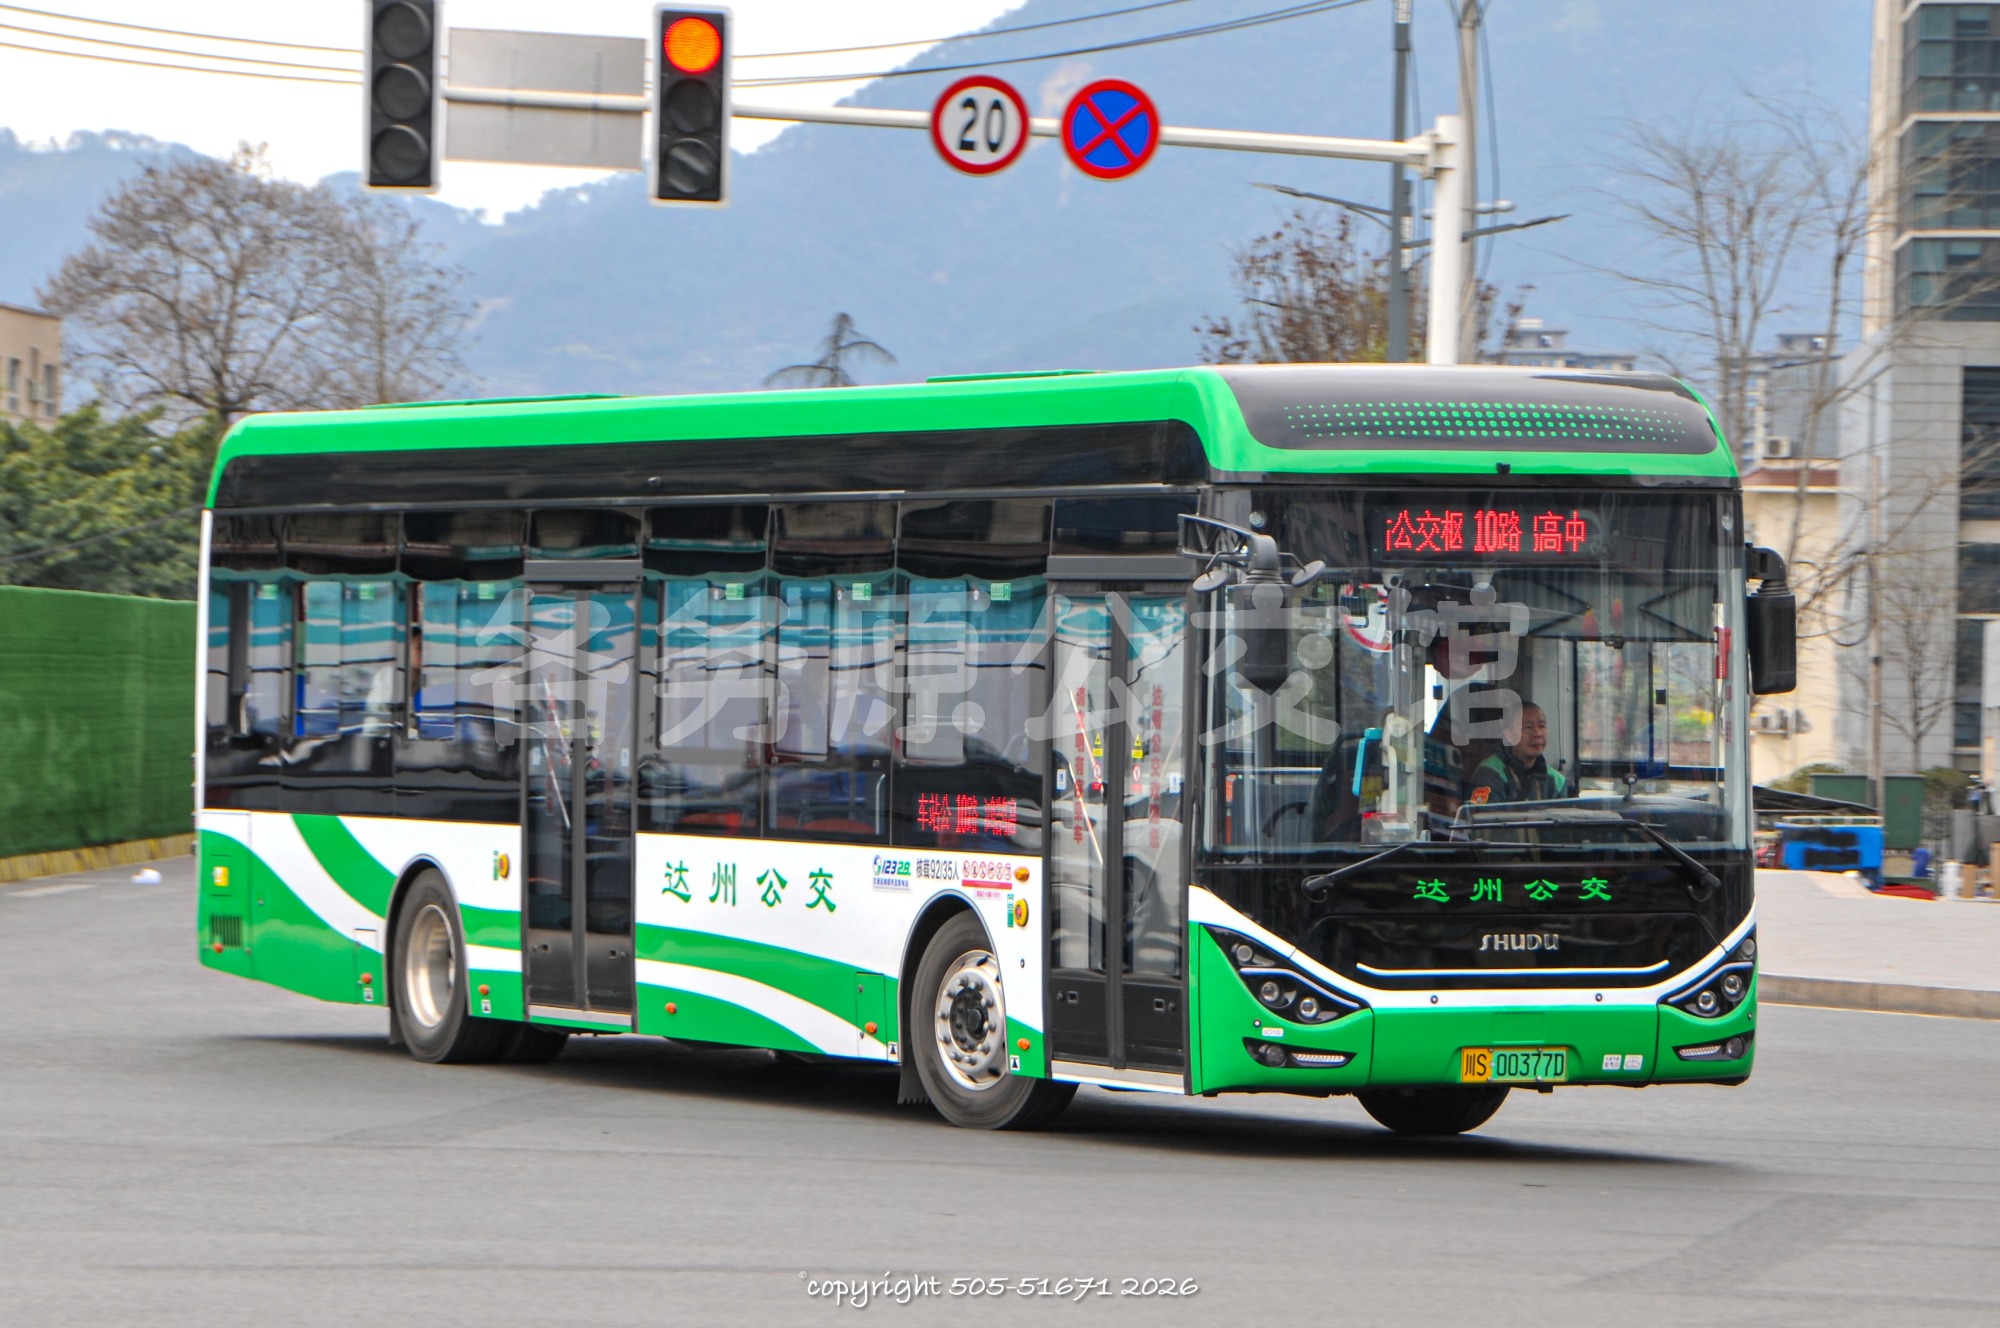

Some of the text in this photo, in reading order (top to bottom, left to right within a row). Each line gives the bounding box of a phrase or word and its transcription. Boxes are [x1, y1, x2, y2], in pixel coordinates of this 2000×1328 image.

[958, 97, 1006, 153] 20
[1473, 509, 1523, 553] 10路
[662, 859, 837, 913] 达州公交
[1412, 876, 1613, 903] 达州公交
[1478, 933, 1560, 951] SHUDU
